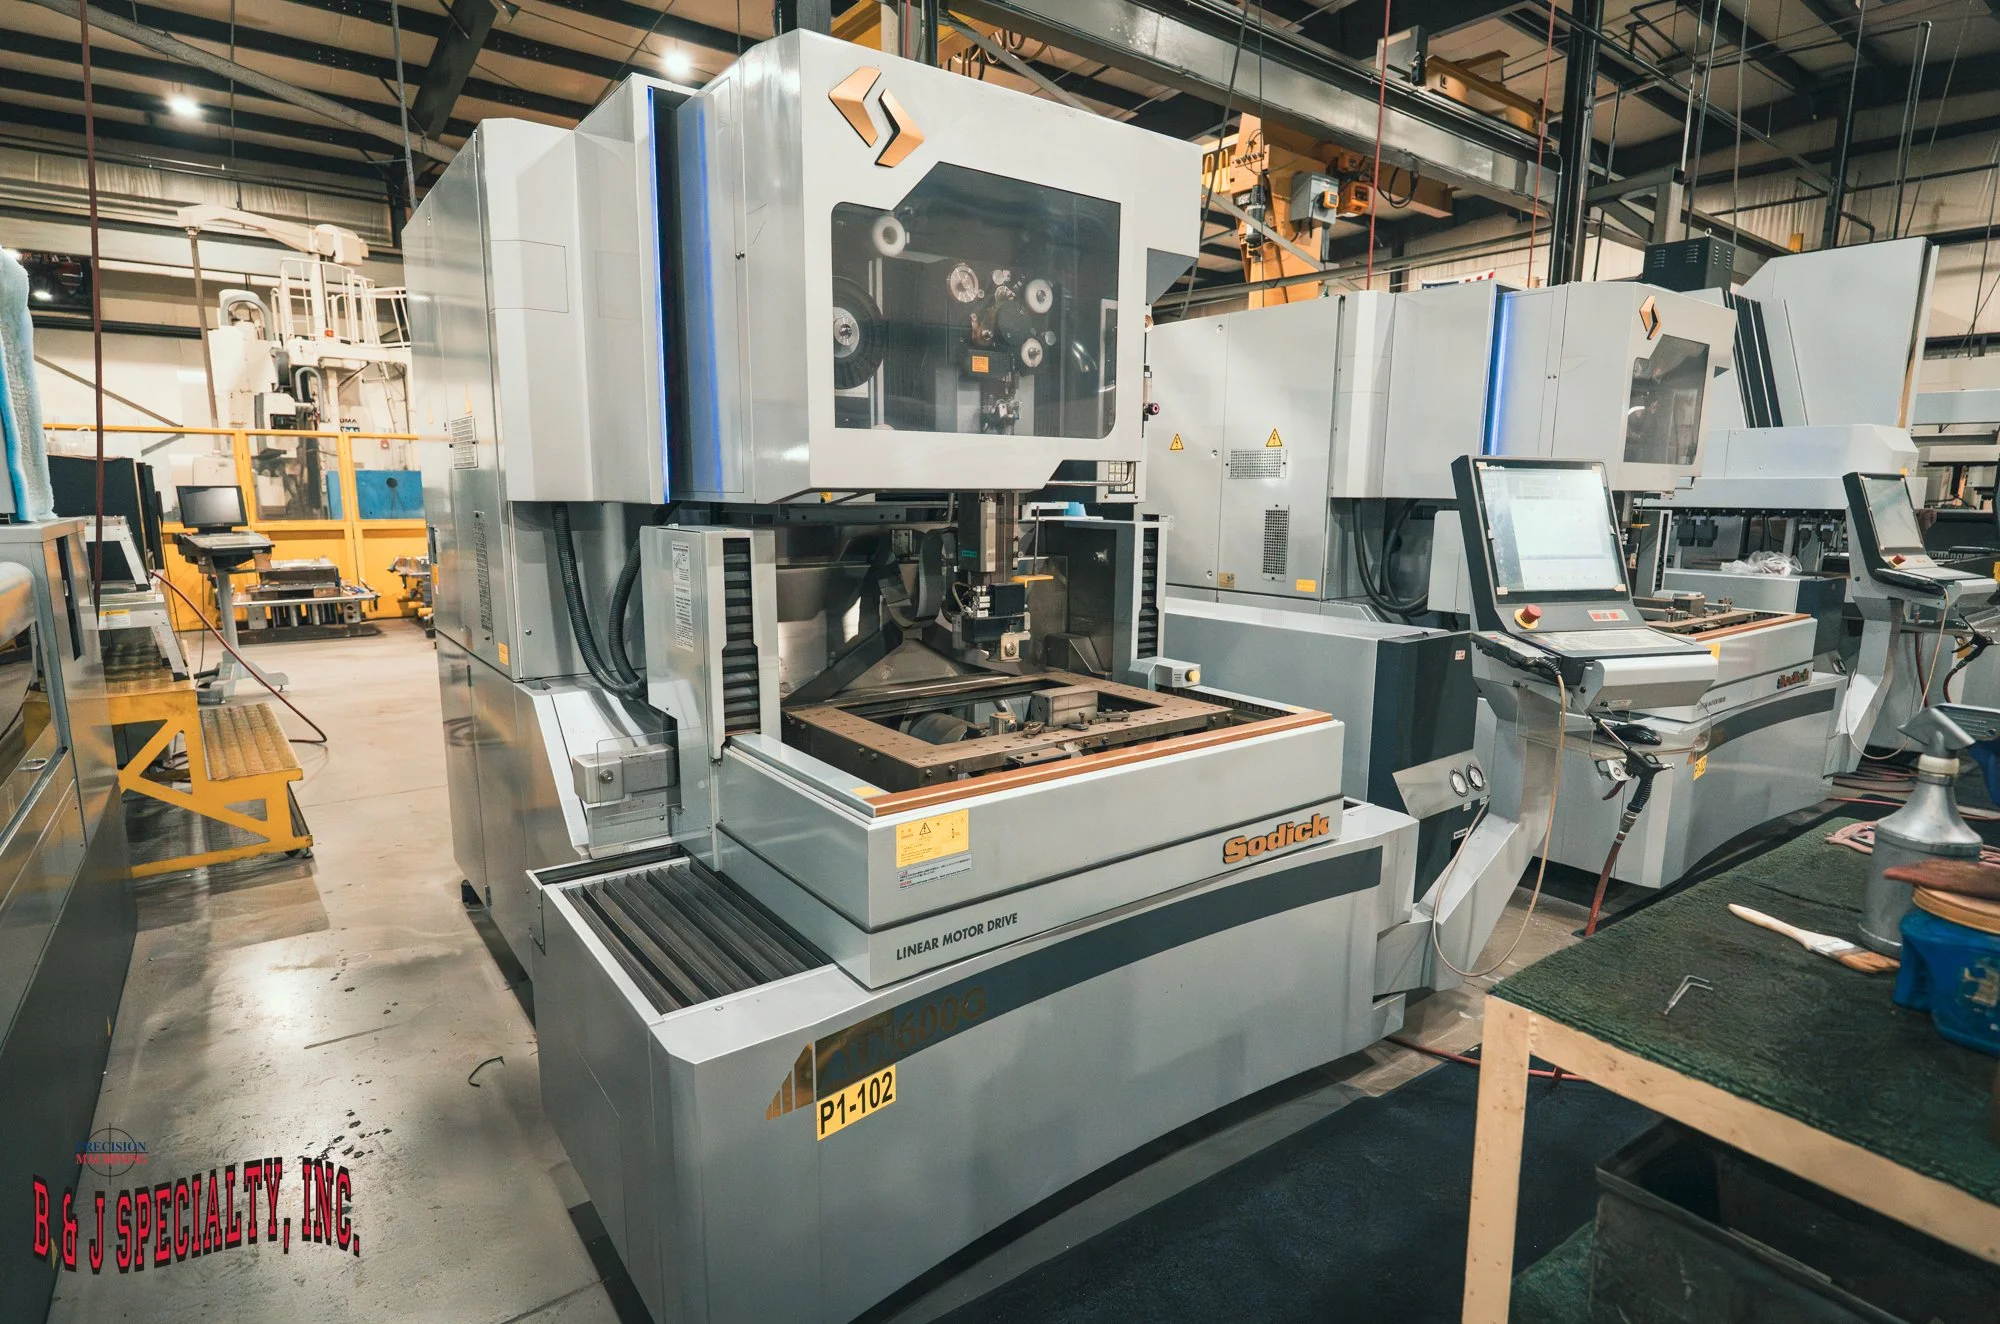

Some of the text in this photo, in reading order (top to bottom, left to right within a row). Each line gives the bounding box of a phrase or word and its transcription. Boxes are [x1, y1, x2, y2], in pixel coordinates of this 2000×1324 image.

[1223, 813, 1330, 864] Sodick
[896, 913, 1018, 960] LINEAR MOTOR DRIVE
[820, 1071, 893, 1135] P1-102
